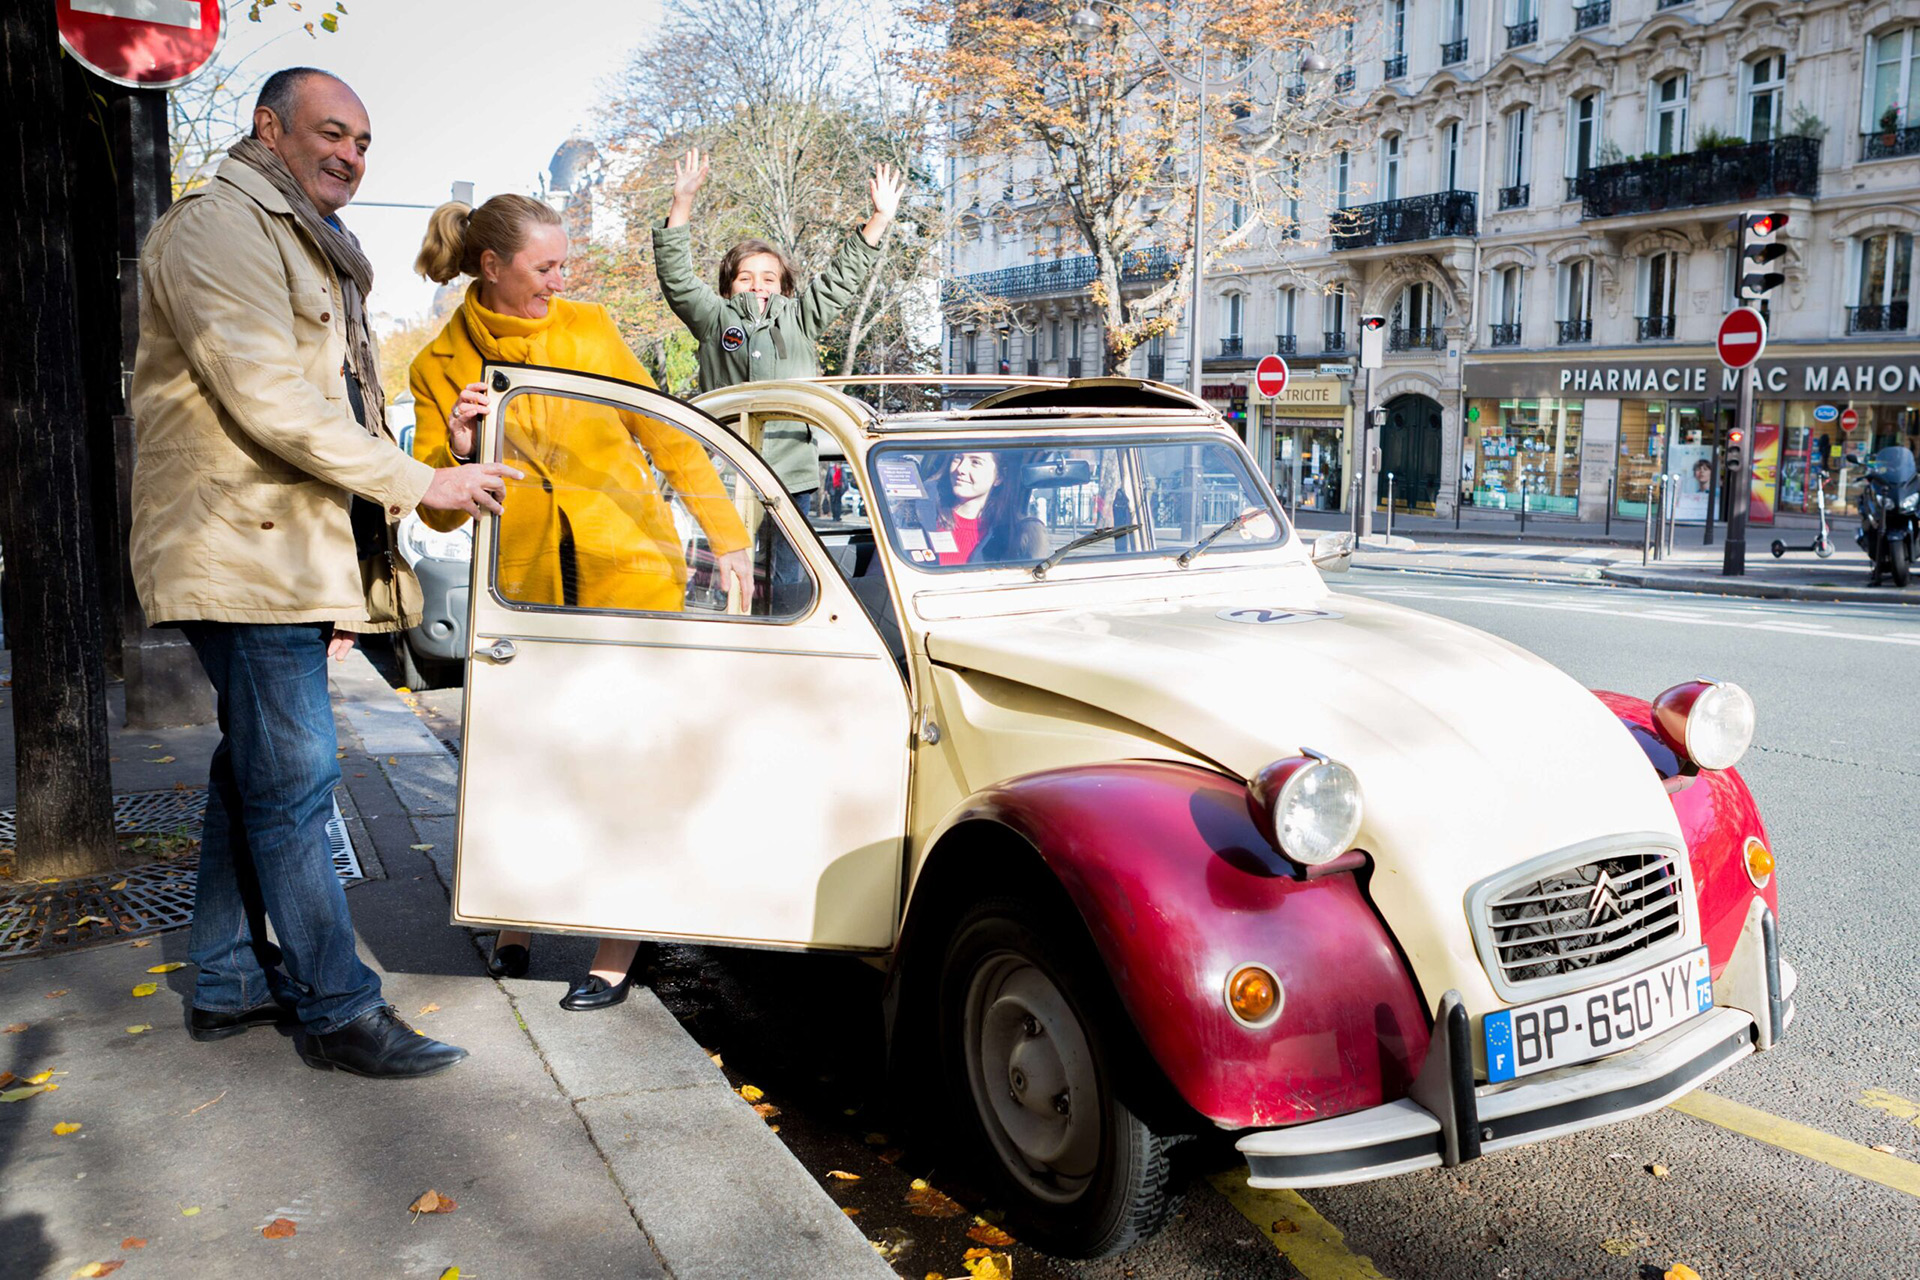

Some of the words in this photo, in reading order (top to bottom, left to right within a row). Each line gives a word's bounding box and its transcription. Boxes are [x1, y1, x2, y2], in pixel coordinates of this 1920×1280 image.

[1560, 368, 1707, 392] PHARMACIE
[1721, 366, 1788, 392] MAC
[1258, 388, 1330, 402] CTRICITÉ
[1697, 983, 1711, 1007] 75
[1514, 961, 1692, 1067] BP-650-YY
[1496, 1054, 1506, 1071] F
